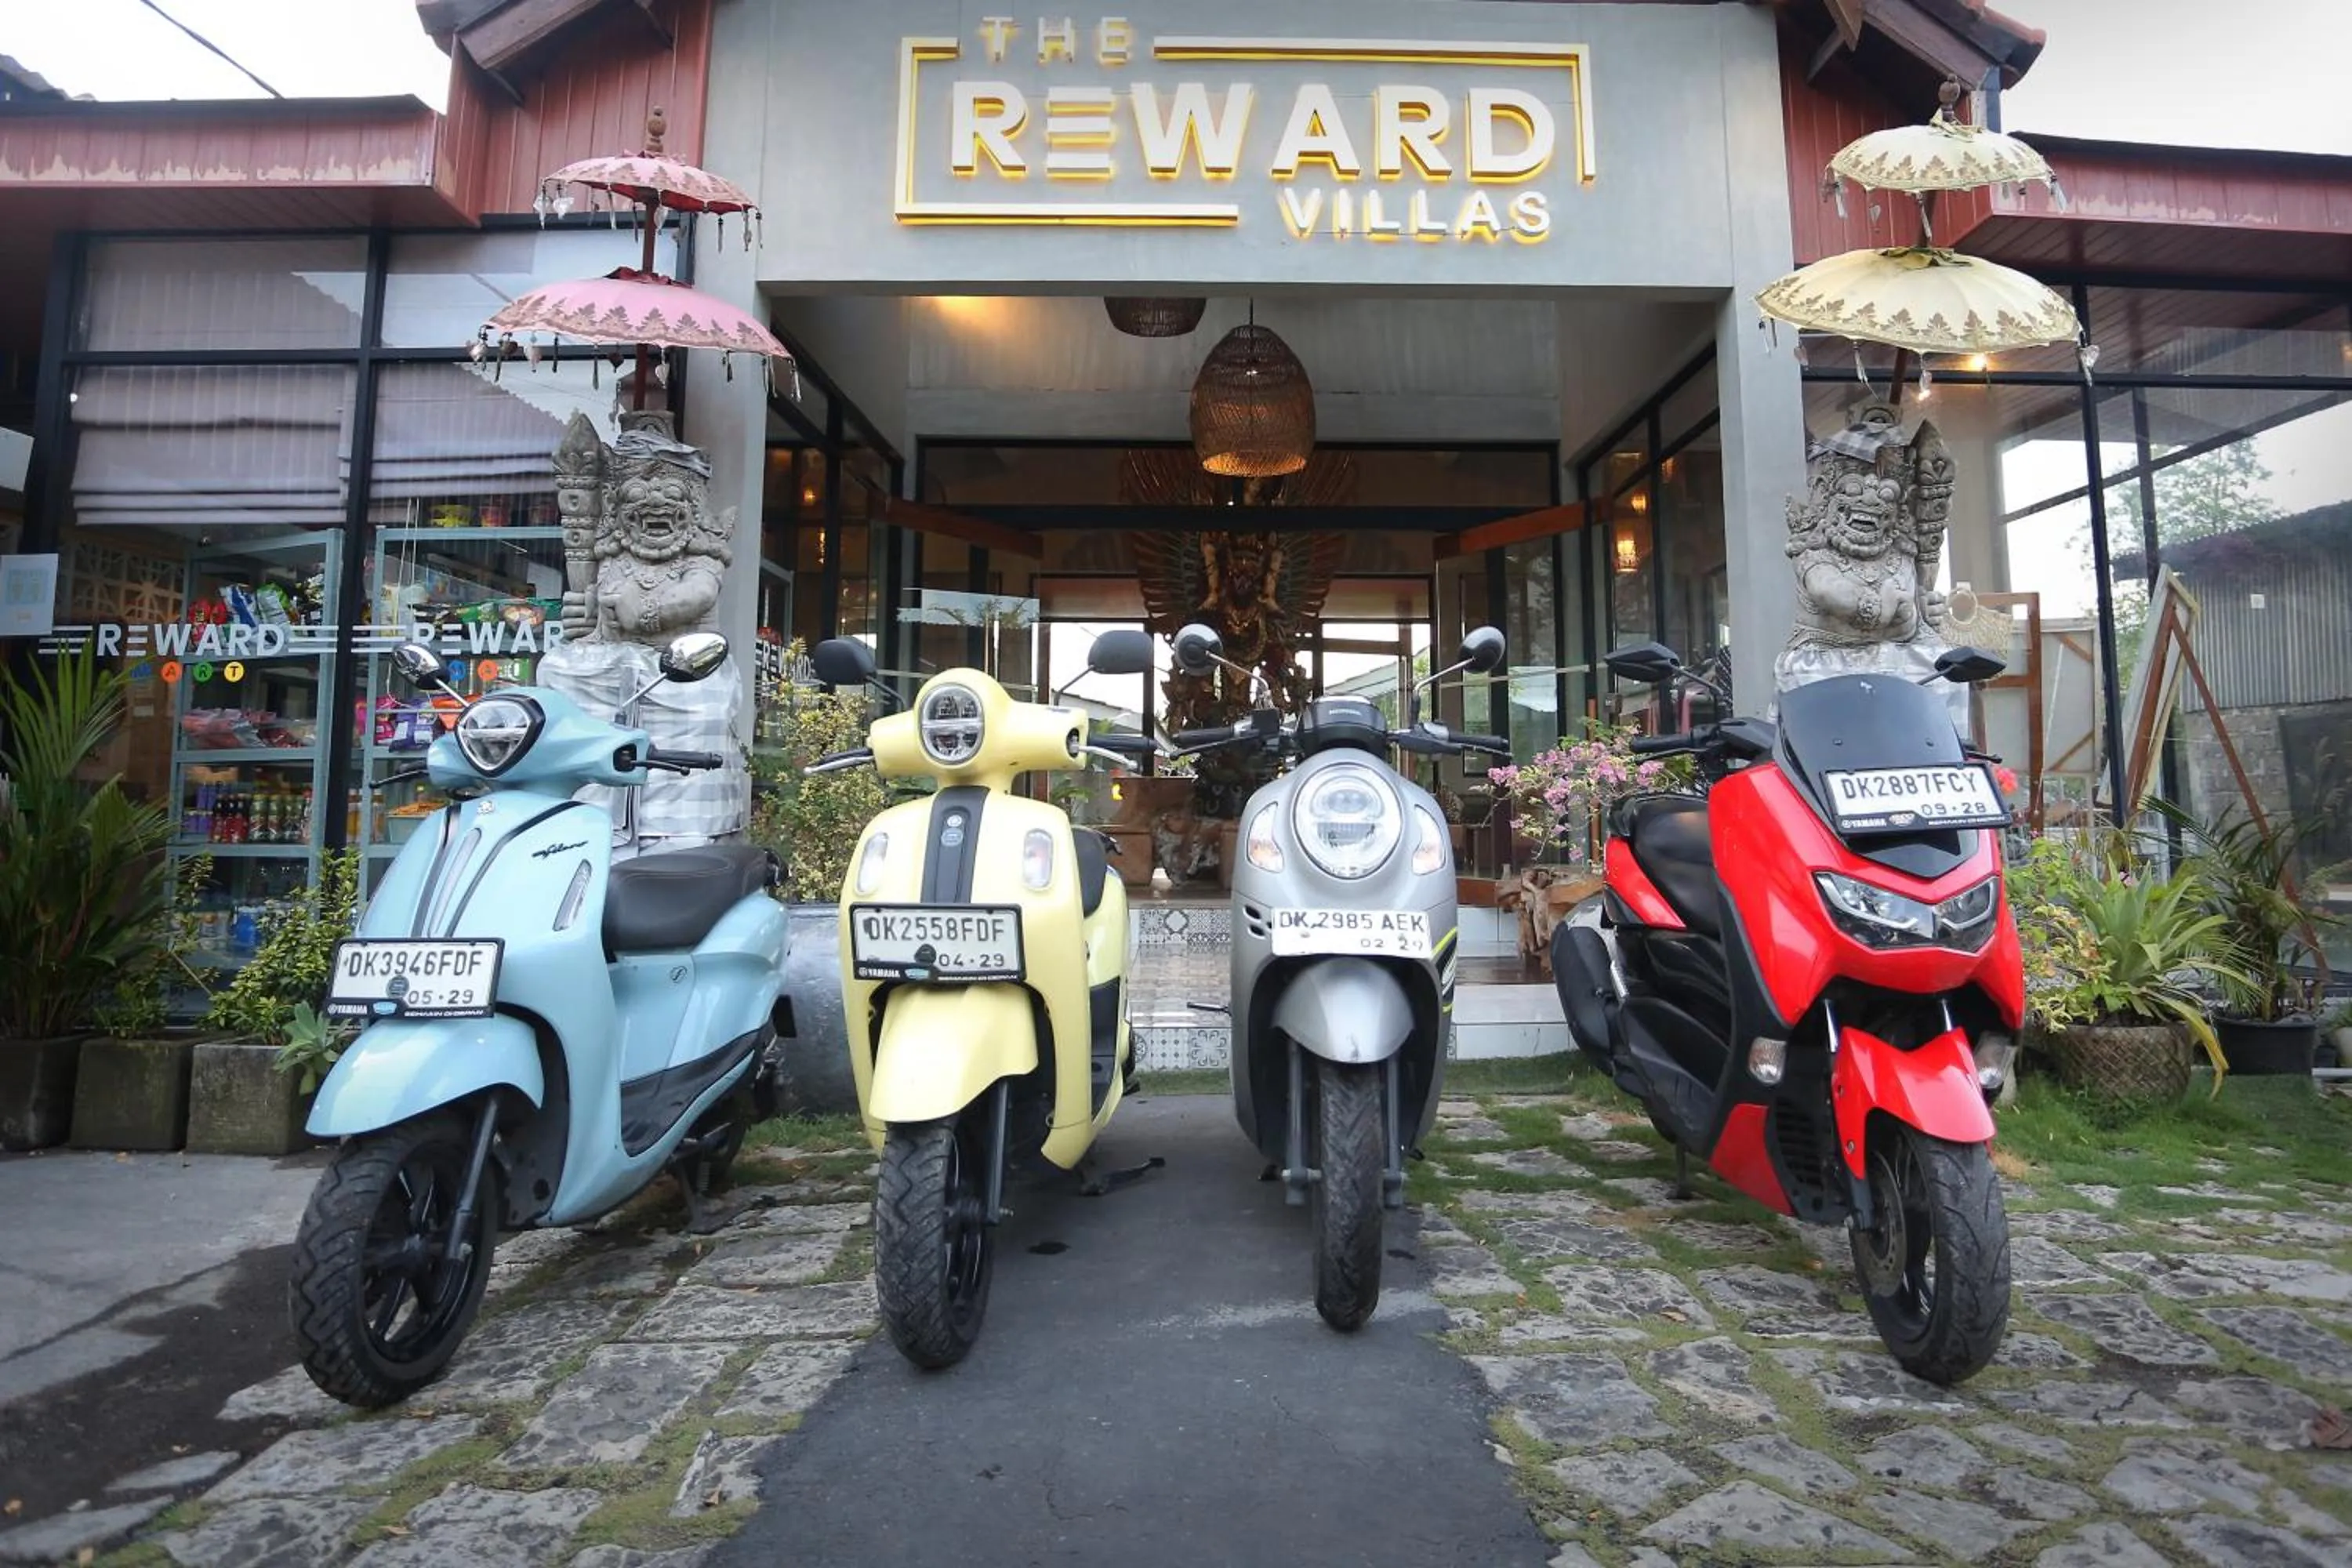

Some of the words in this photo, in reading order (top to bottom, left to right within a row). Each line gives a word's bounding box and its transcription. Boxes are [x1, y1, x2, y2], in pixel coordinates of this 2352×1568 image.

[981, 17, 1131, 63] THE
[951, 81, 1557, 182] REWARD
[1279, 186, 1552, 240] VILLAS
[96, 623, 285, 656] REWARD
[412, 621, 564, 655] REWAR
[1840, 771, 1976, 800] DK2887FCY
[869, 916, 1004, 942] DK2558FDF
[348, 949, 483, 977] DK3946FDF
